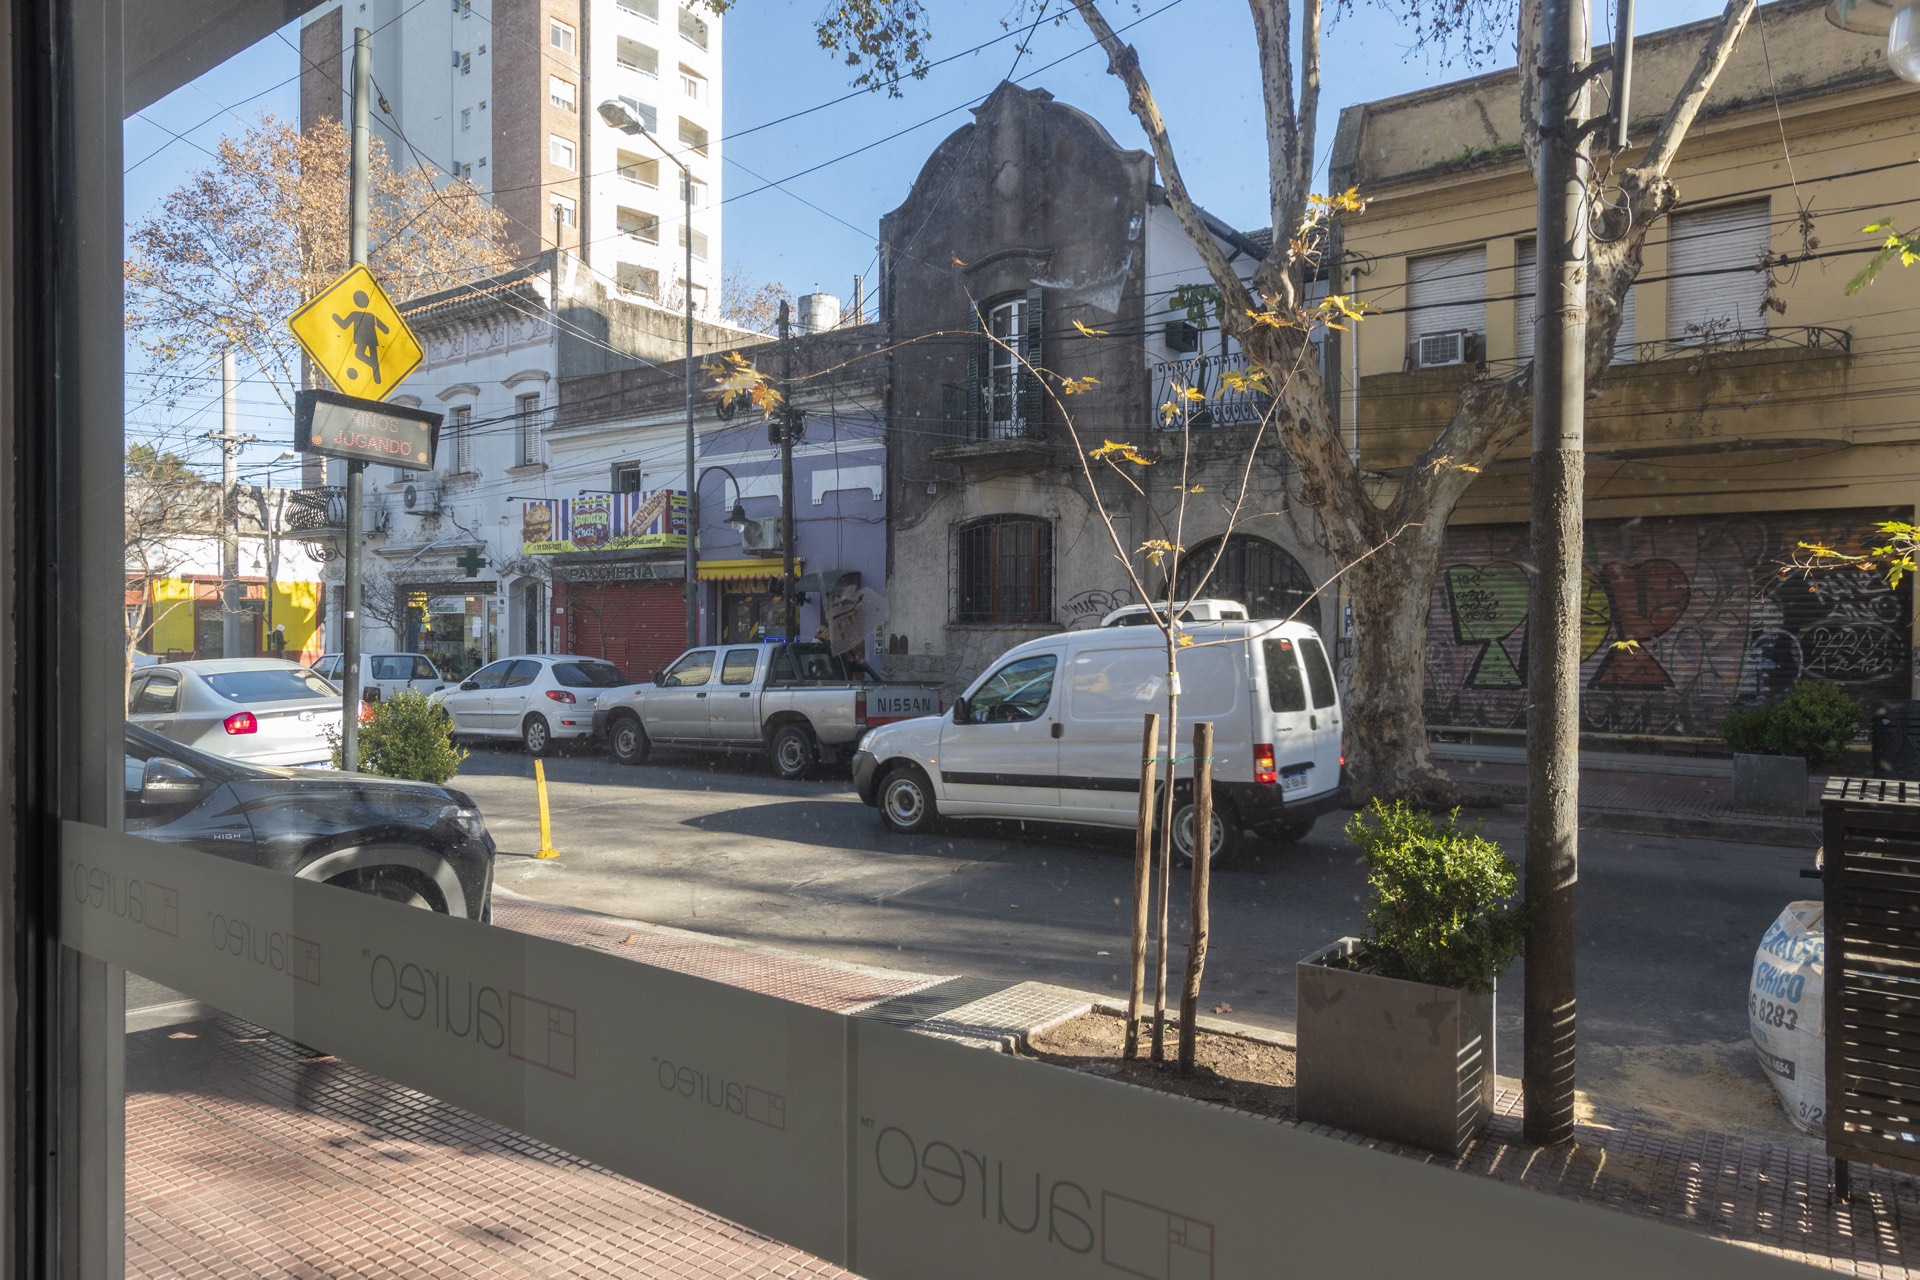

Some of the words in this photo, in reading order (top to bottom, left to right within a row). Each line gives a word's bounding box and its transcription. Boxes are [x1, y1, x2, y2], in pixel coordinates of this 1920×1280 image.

[334, 430, 412, 456] JUGANDO
[574, 512, 608, 527] BURGER
[877, 698, 931, 712] NISSAN
[1756, 961, 1805, 1004] CHICO
[1759, 998, 1798, 1031] 8283
